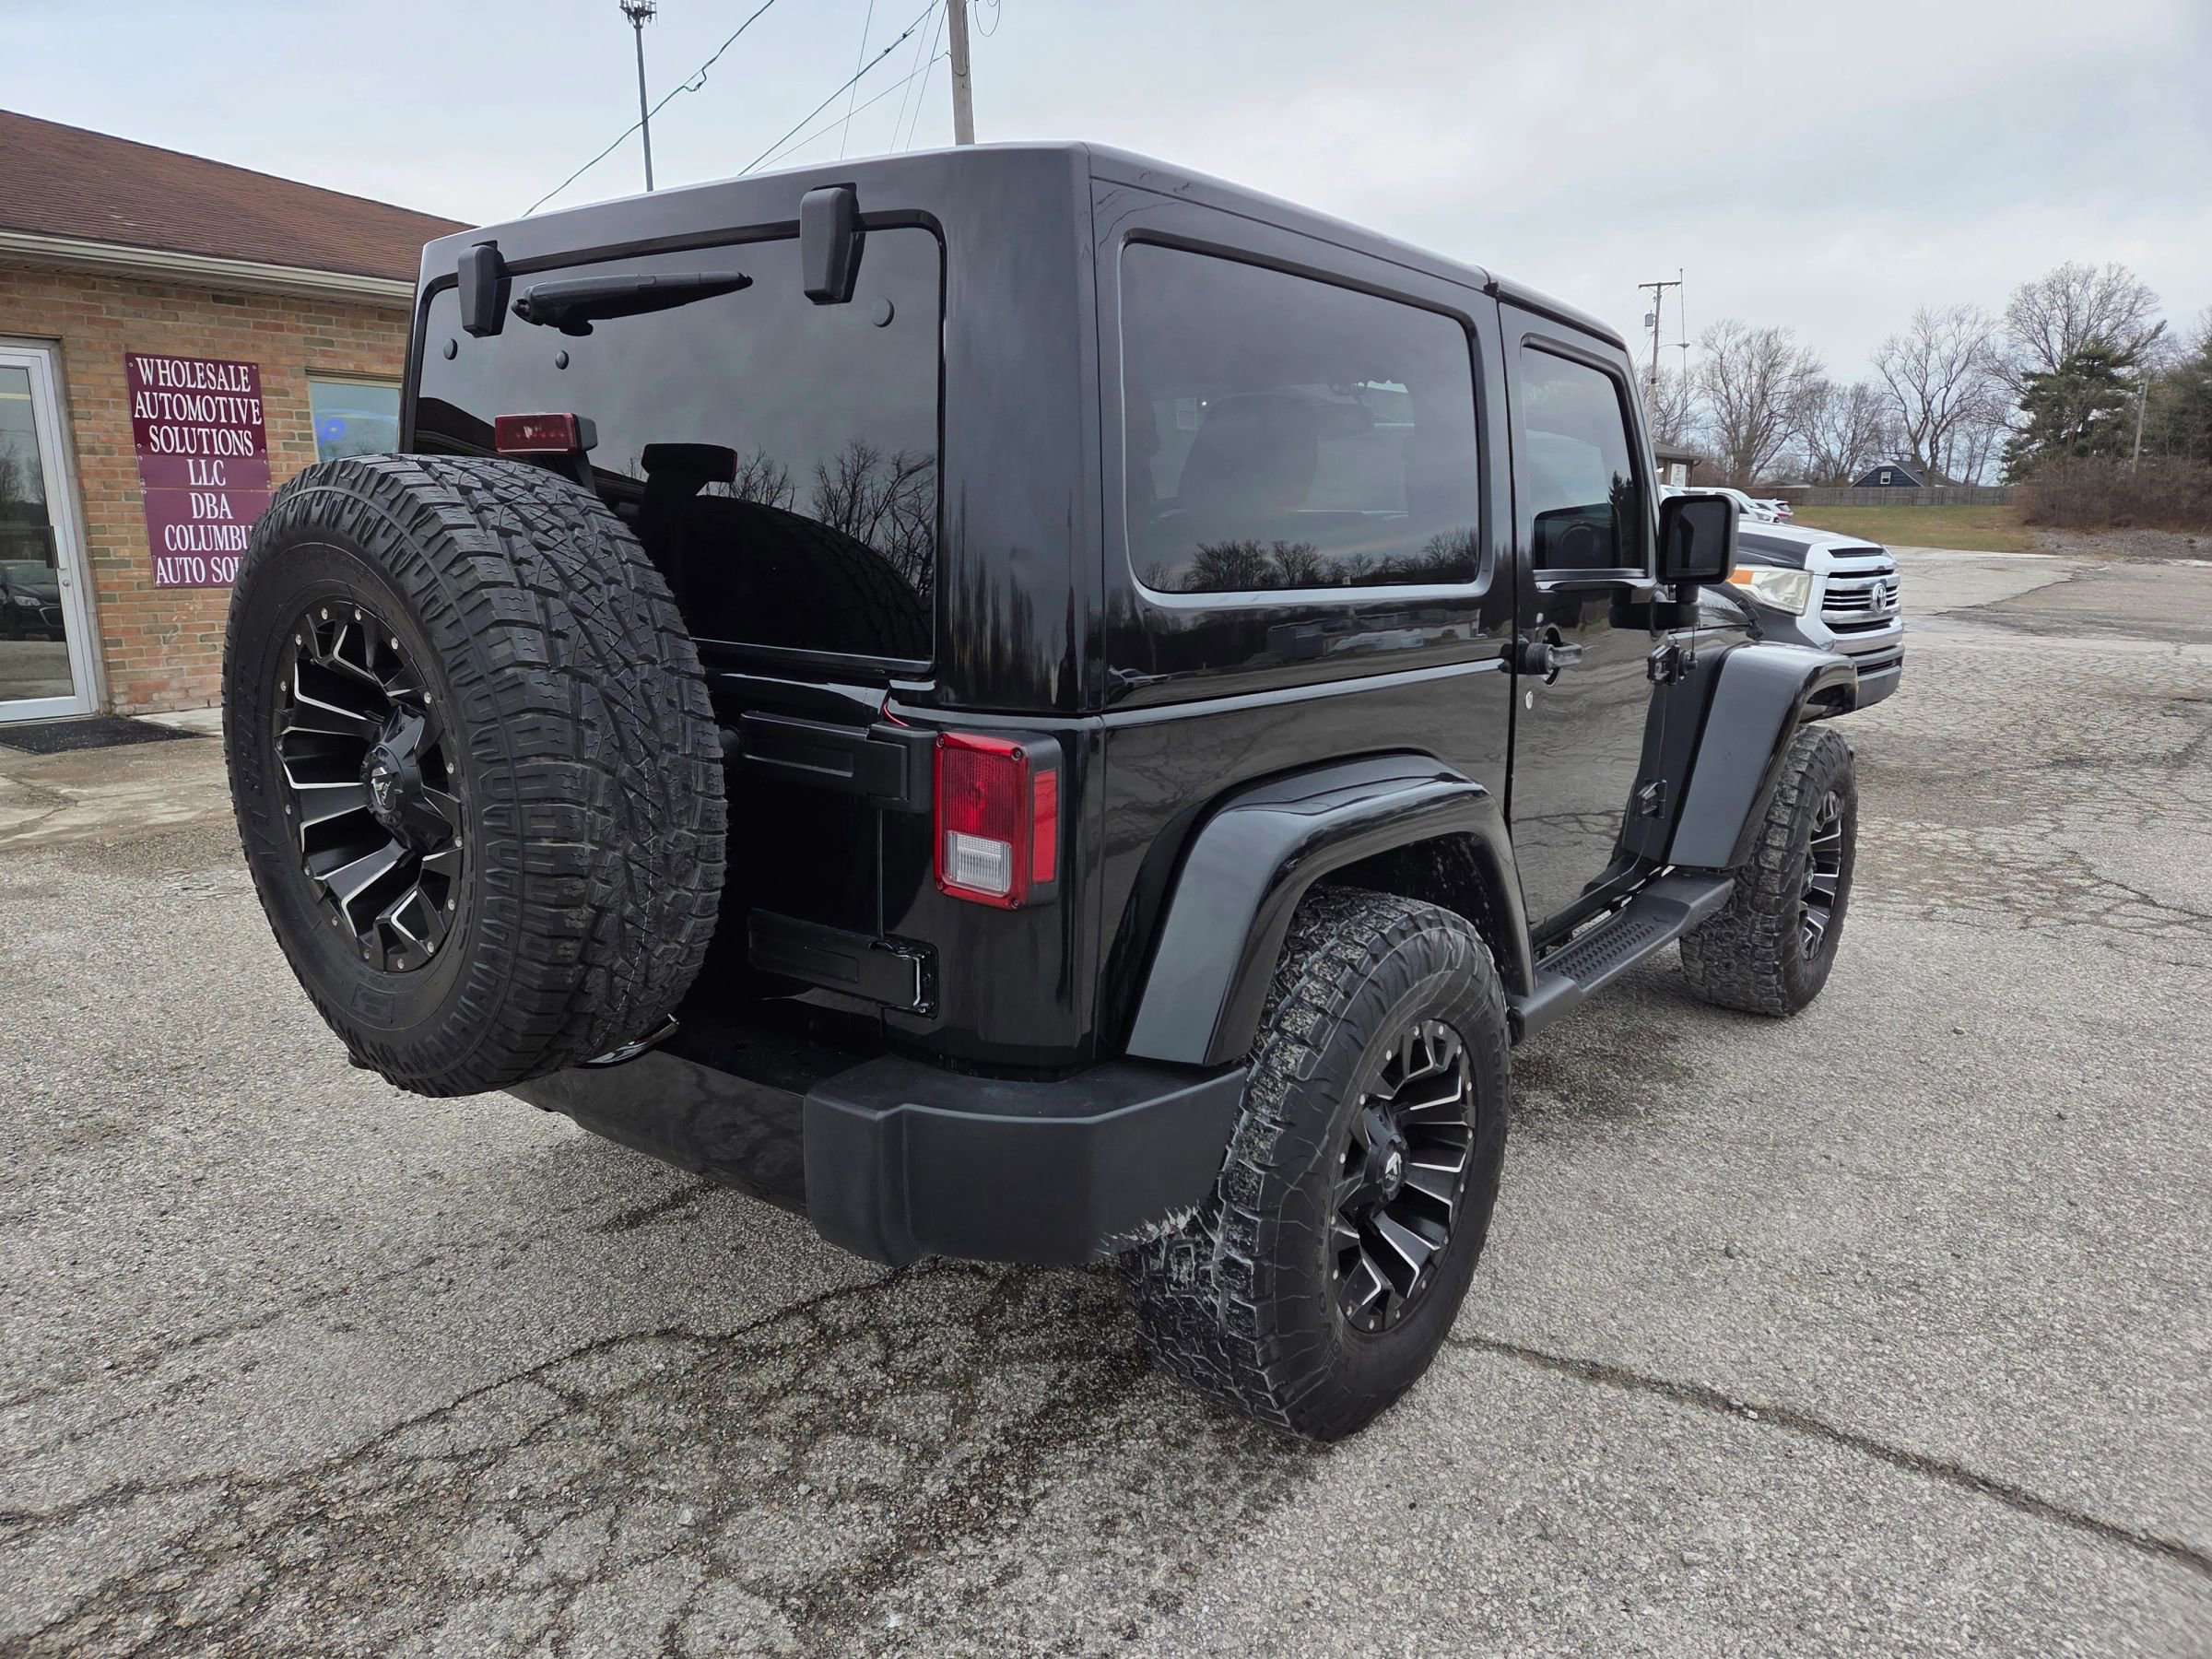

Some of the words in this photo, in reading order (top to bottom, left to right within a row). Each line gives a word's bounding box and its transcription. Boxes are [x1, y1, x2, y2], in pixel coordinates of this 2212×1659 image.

[135, 358, 251, 393] WHOLESALE
[134, 391, 262, 426] AUTOMOTIVE
[148, 425, 254, 457] SOLUTIONS
[187, 459, 227, 486] LLC
[190, 492, 234, 520] DBA
[155, 557, 206, 584] AUTO
